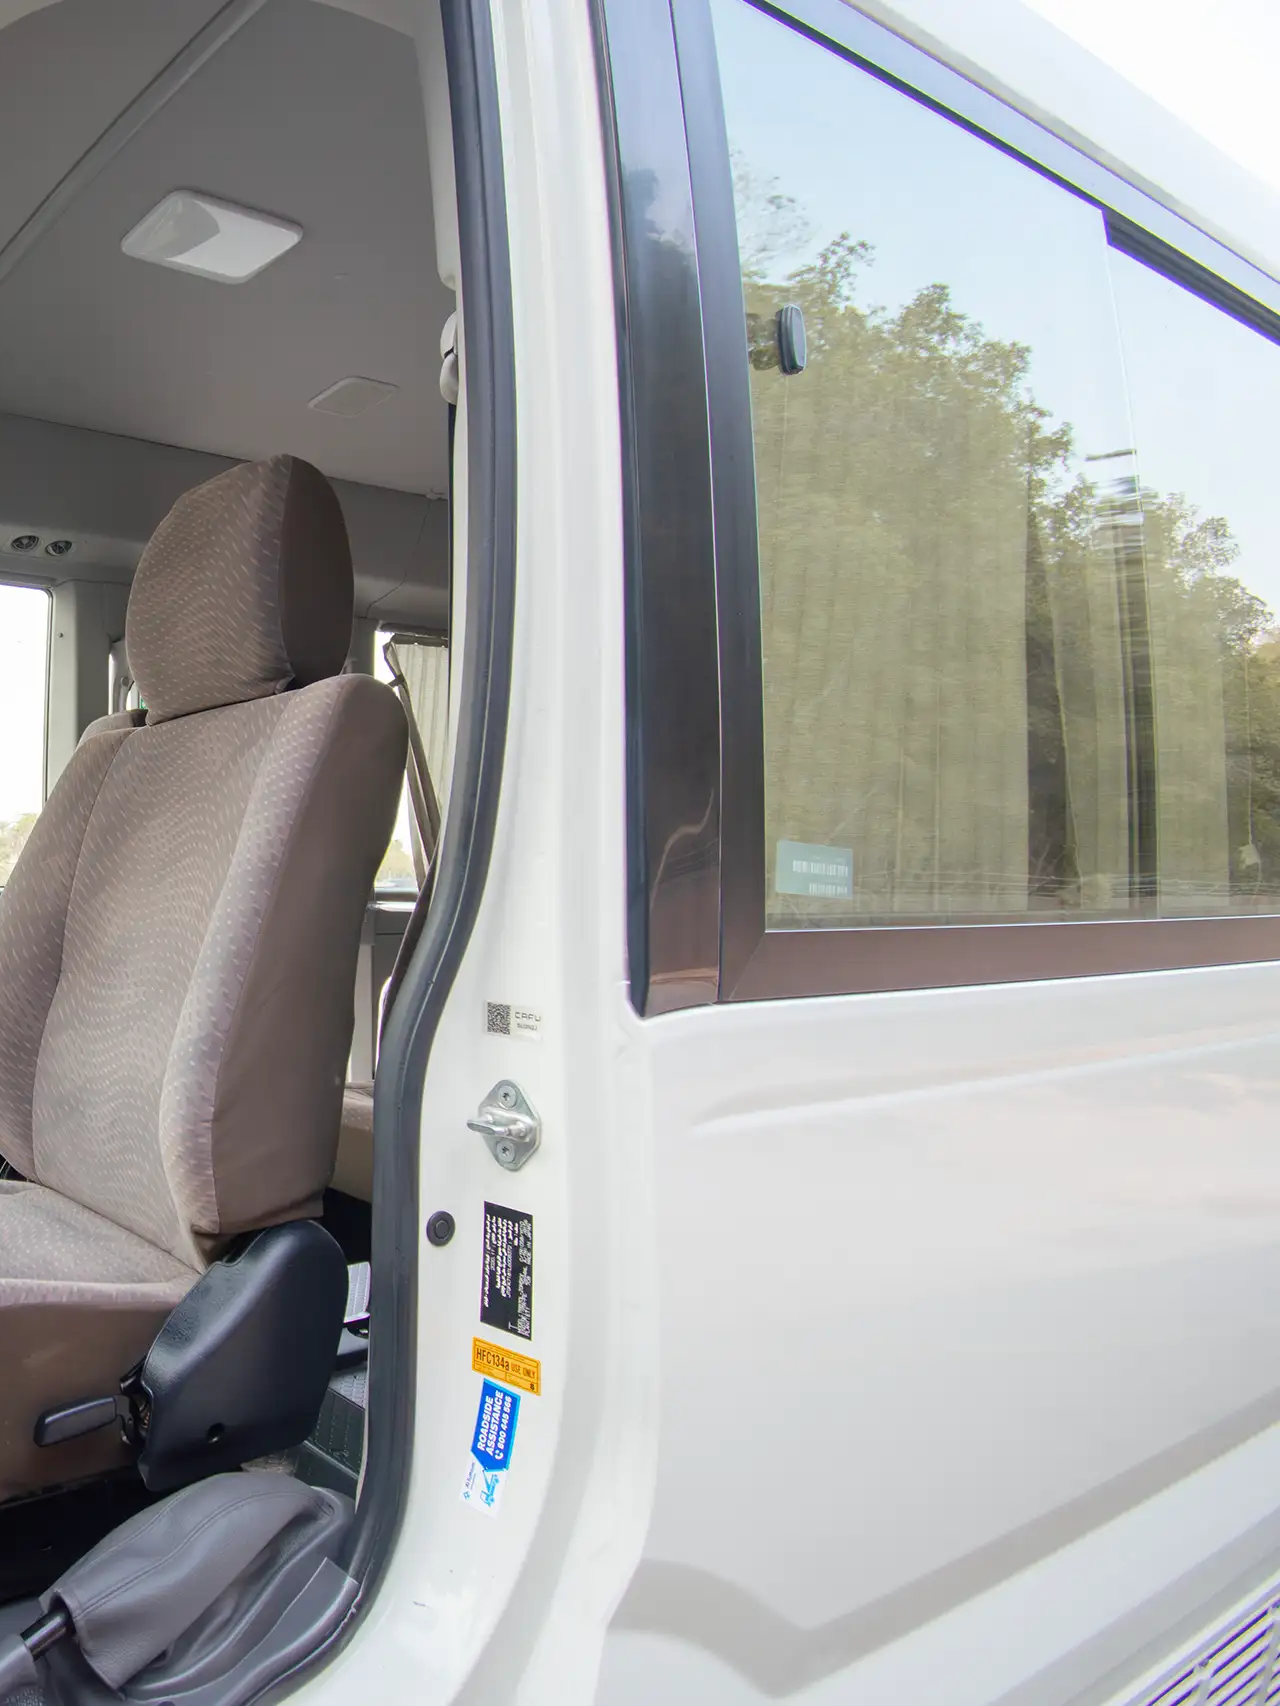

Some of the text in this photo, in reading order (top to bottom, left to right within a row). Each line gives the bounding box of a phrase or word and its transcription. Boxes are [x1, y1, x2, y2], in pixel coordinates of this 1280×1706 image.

[476, 1347, 510, 1371] HFC134a
[477, 1395, 494, 1451] ROADSIDE
[485, 1390, 504, 1456] ASSISTANCE
[500, 1414, 509, 1431] 445
[497, 1431, 507, 1450] 800
